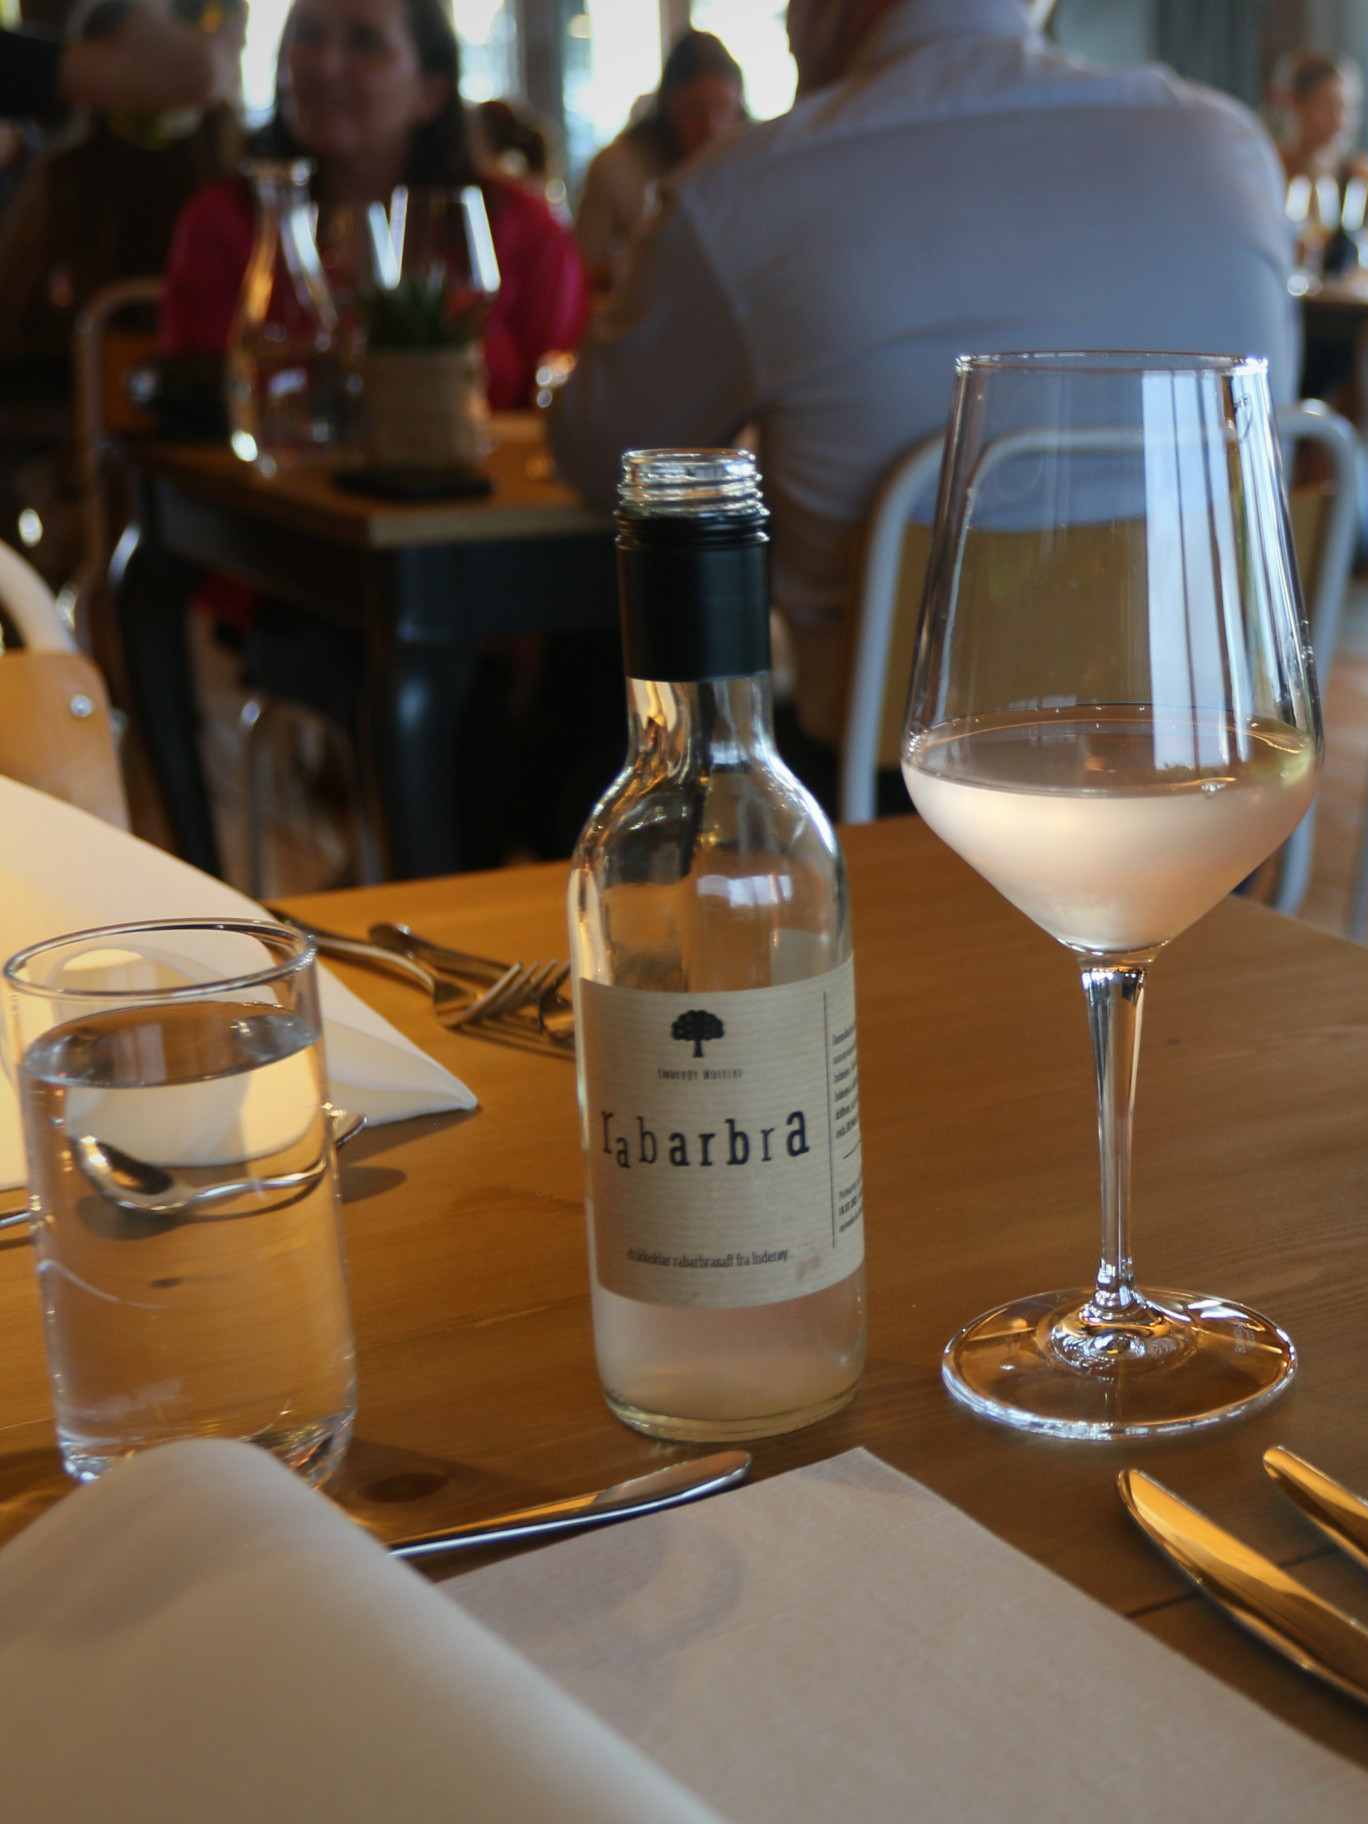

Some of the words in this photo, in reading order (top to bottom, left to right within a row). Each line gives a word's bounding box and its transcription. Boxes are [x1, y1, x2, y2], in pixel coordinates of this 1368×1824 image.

[601, 1110, 810, 1168] rabarbra
[736, 1252, 750, 1267] fra
[751, 1248, 788, 1265] Inderøy
